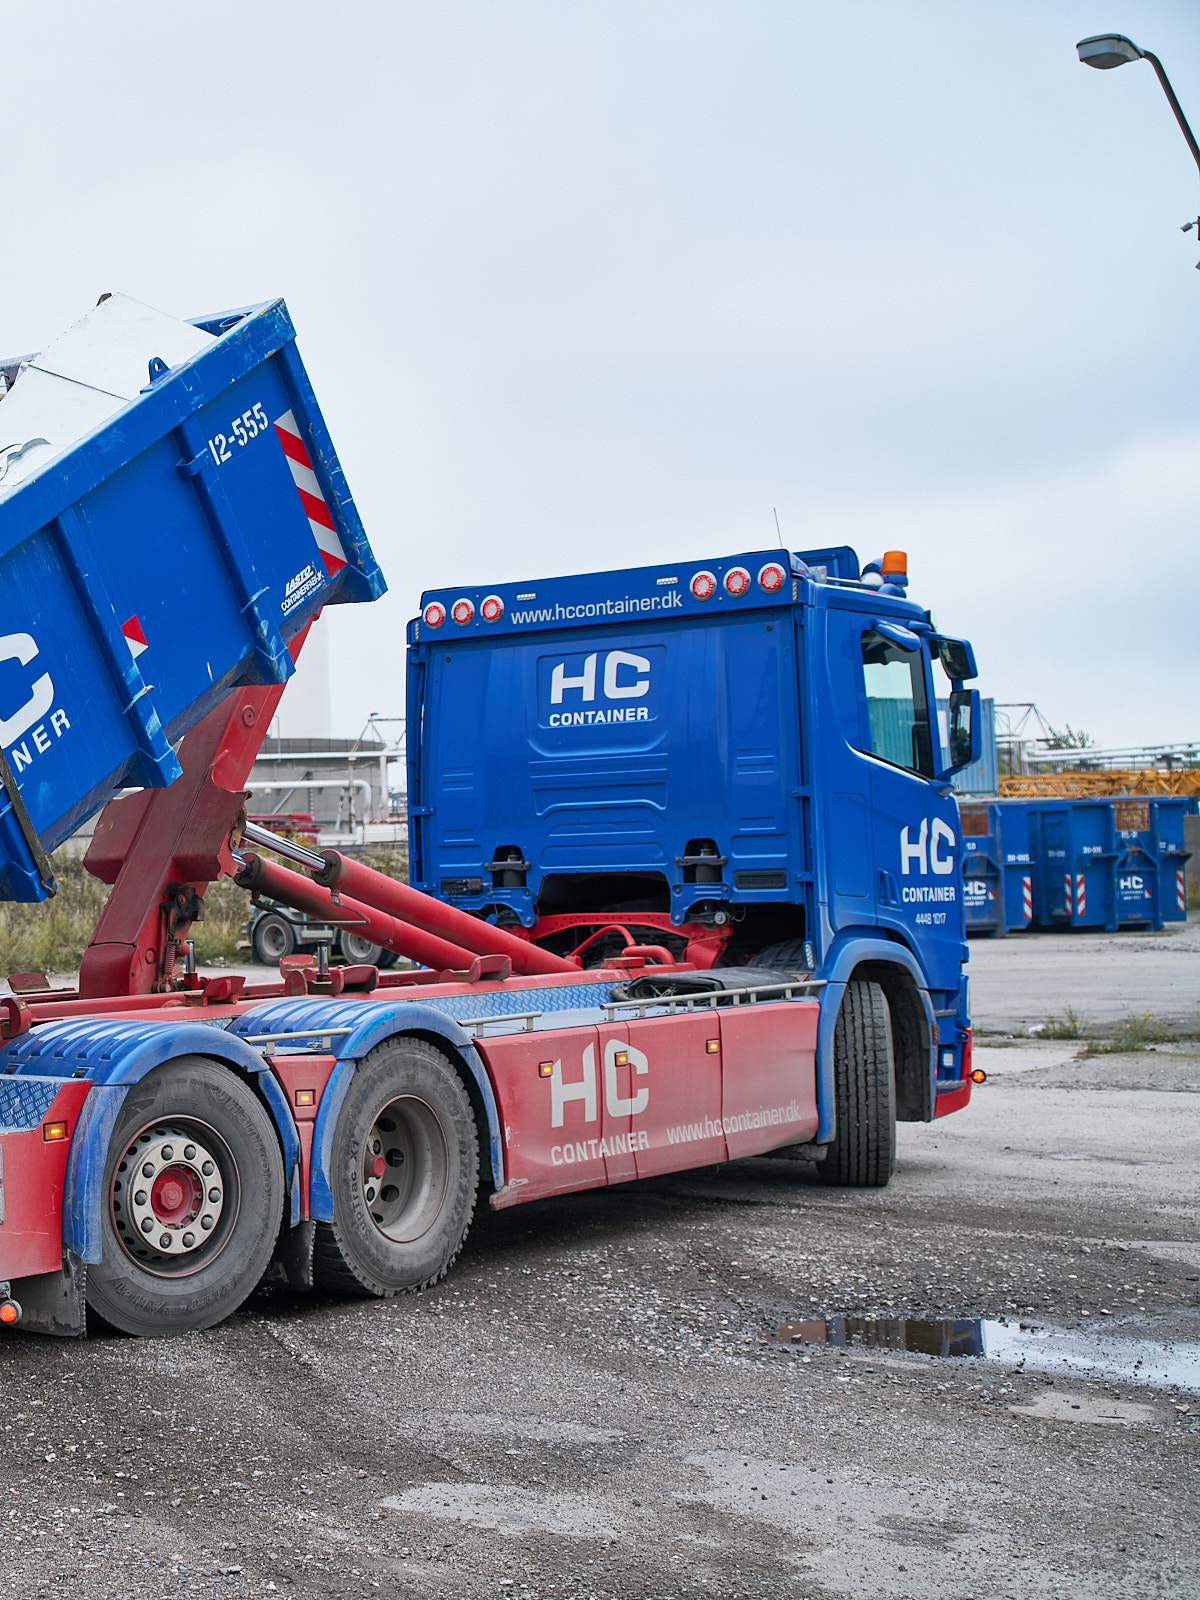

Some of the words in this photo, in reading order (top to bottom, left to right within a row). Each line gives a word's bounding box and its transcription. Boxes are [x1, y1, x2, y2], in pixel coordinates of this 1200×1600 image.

[208, 402, 269, 466] 12-555
[285, 565, 314, 597] LASTO
[511, 590, 683, 625] www.hccontainer.dk
[550, 650, 651, 705] HC
[549, 706, 649, 727] CONTAINER
[900, 817, 956, 875] HC
[902, 886, 956, 903] CONTAINER
[963, 881, 987, 895] HC
[1120, 875, 1144, 890] HC
[915, 913, 932, 925] 4448
[933, 913, 947, 925] 1017
[550, 1038, 650, 1129] HC
[666, 1099, 803, 1145] www.hccontainer.dk
[550, 1130, 650, 1166] CONTAINER
